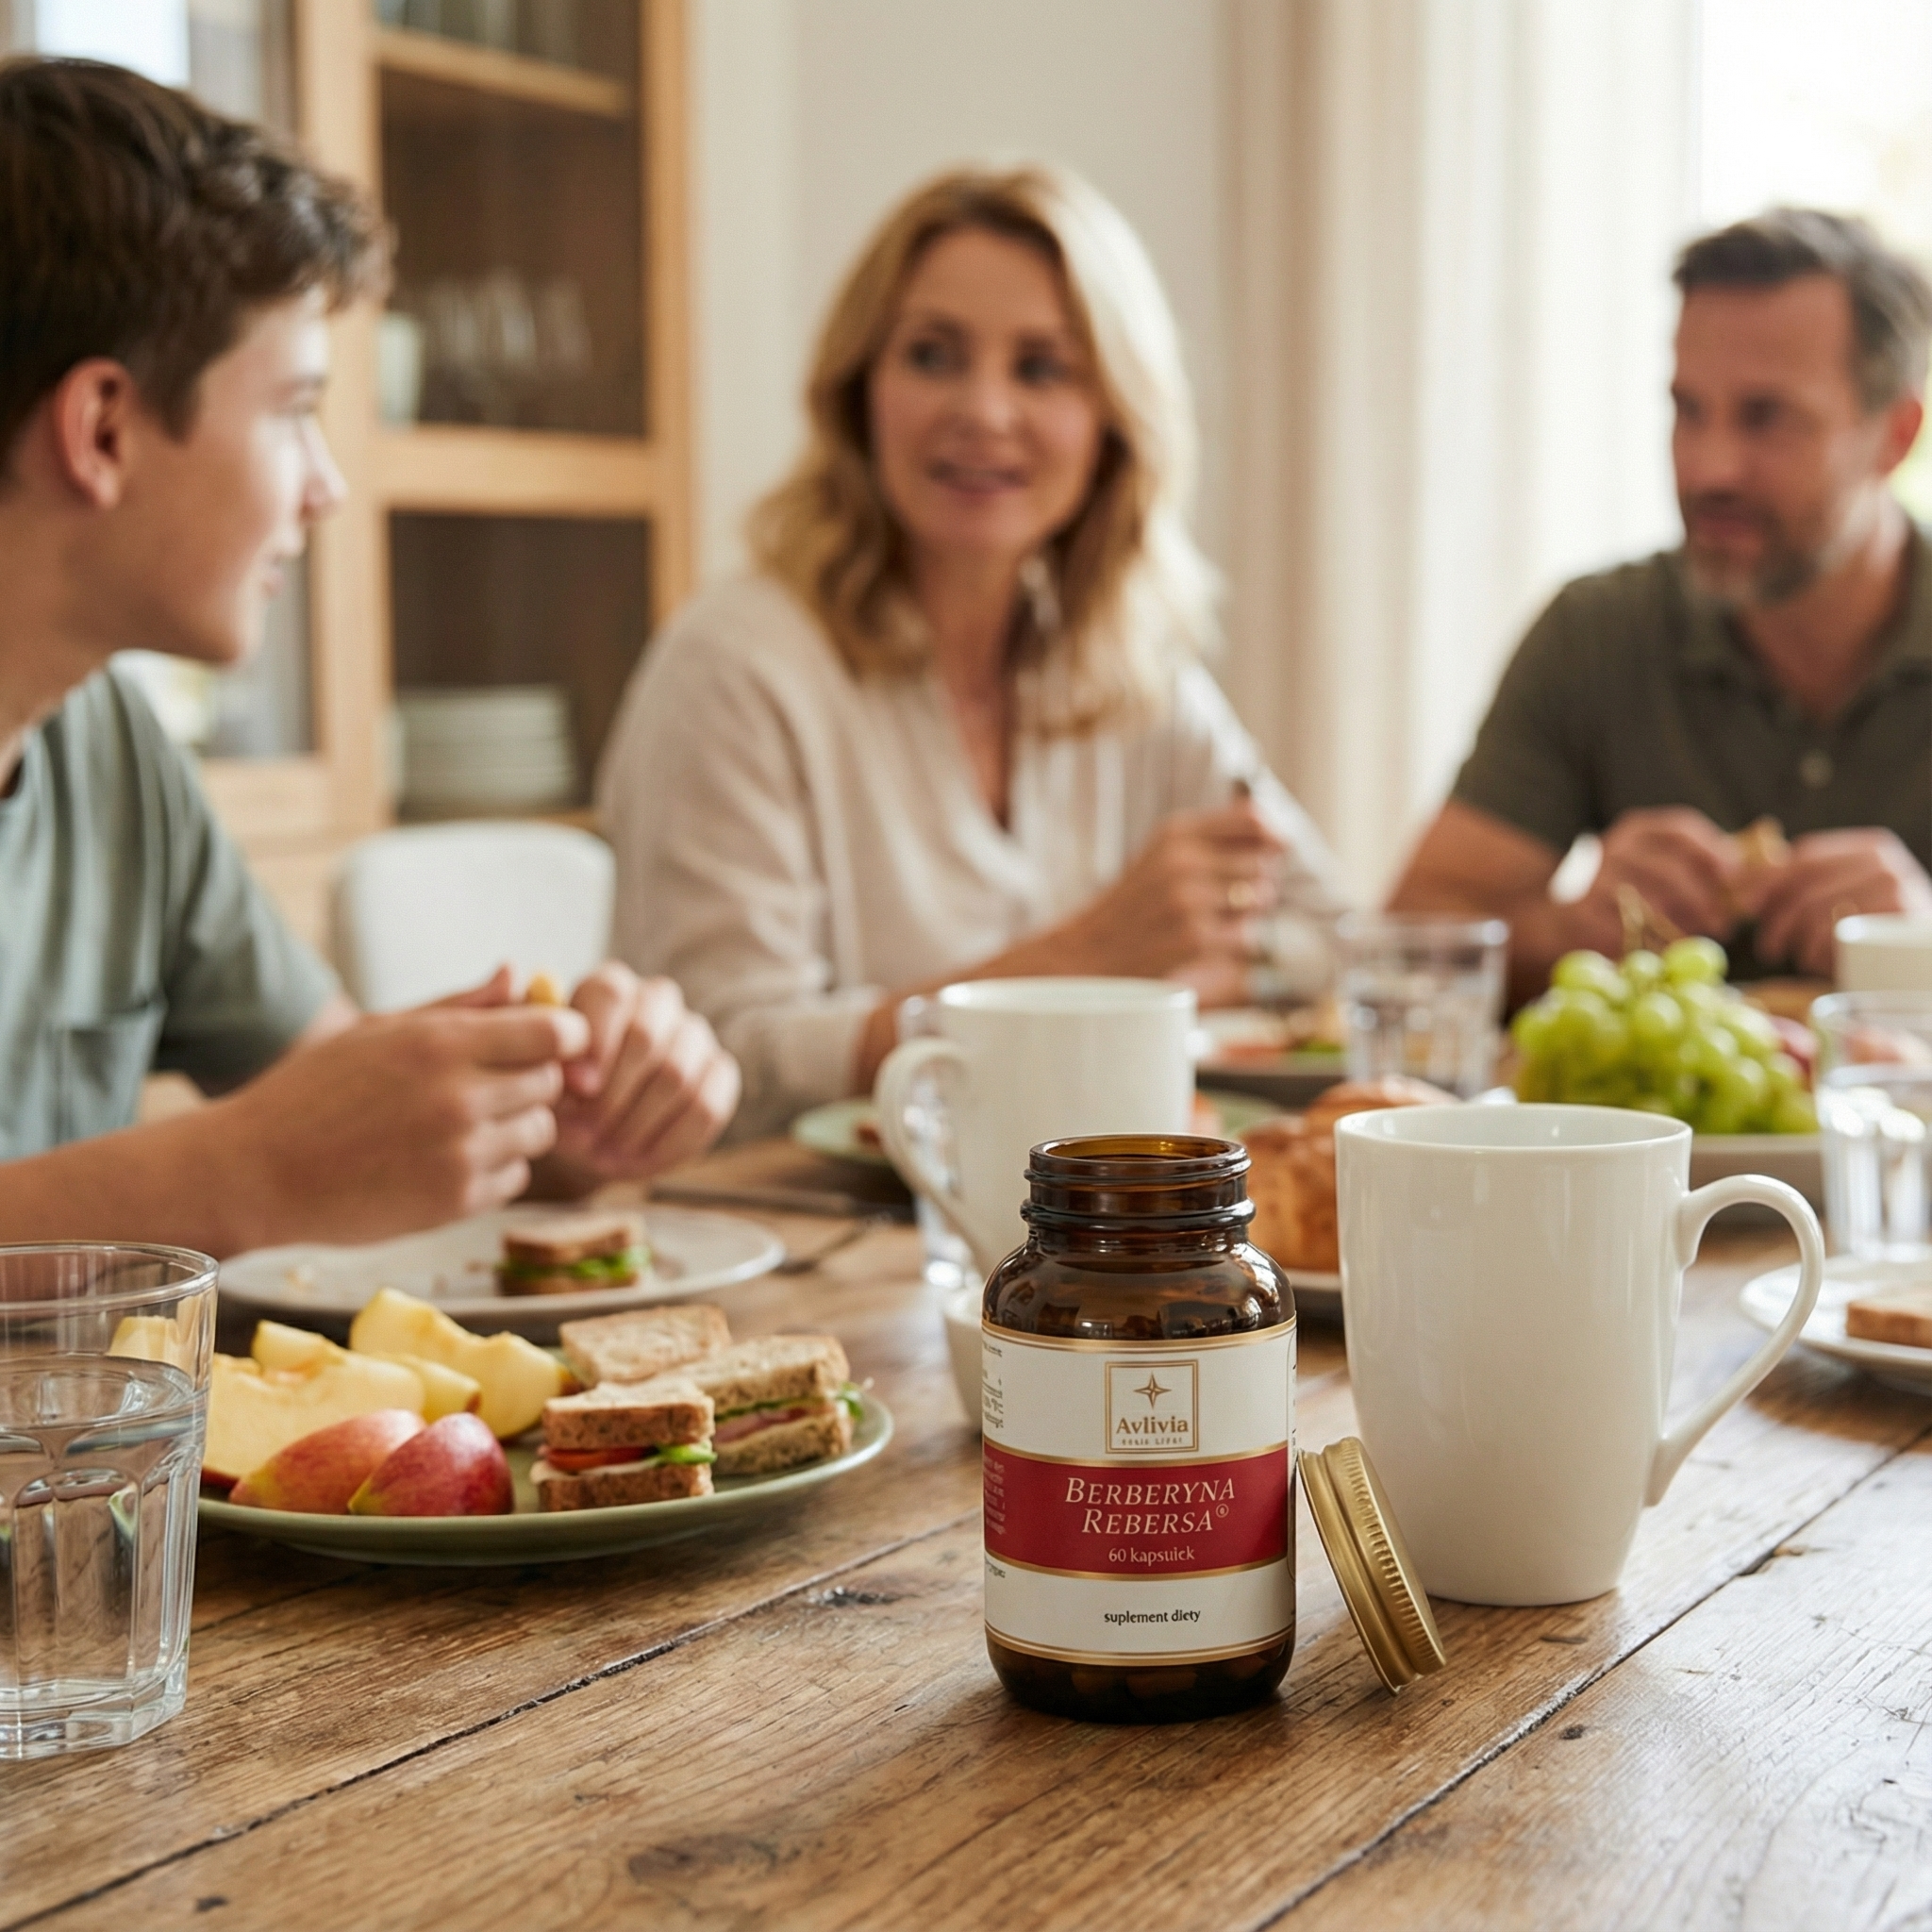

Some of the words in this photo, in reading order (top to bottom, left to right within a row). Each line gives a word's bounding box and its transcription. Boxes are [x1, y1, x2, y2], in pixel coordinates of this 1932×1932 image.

[1115, 1415, 1189, 1435] Avlivia
[1065, 1476, 1236, 1506] BERBERYNA
[1108, 1547, 1127, 1562] 60
[1104, 1610, 1169, 1626] suplement
